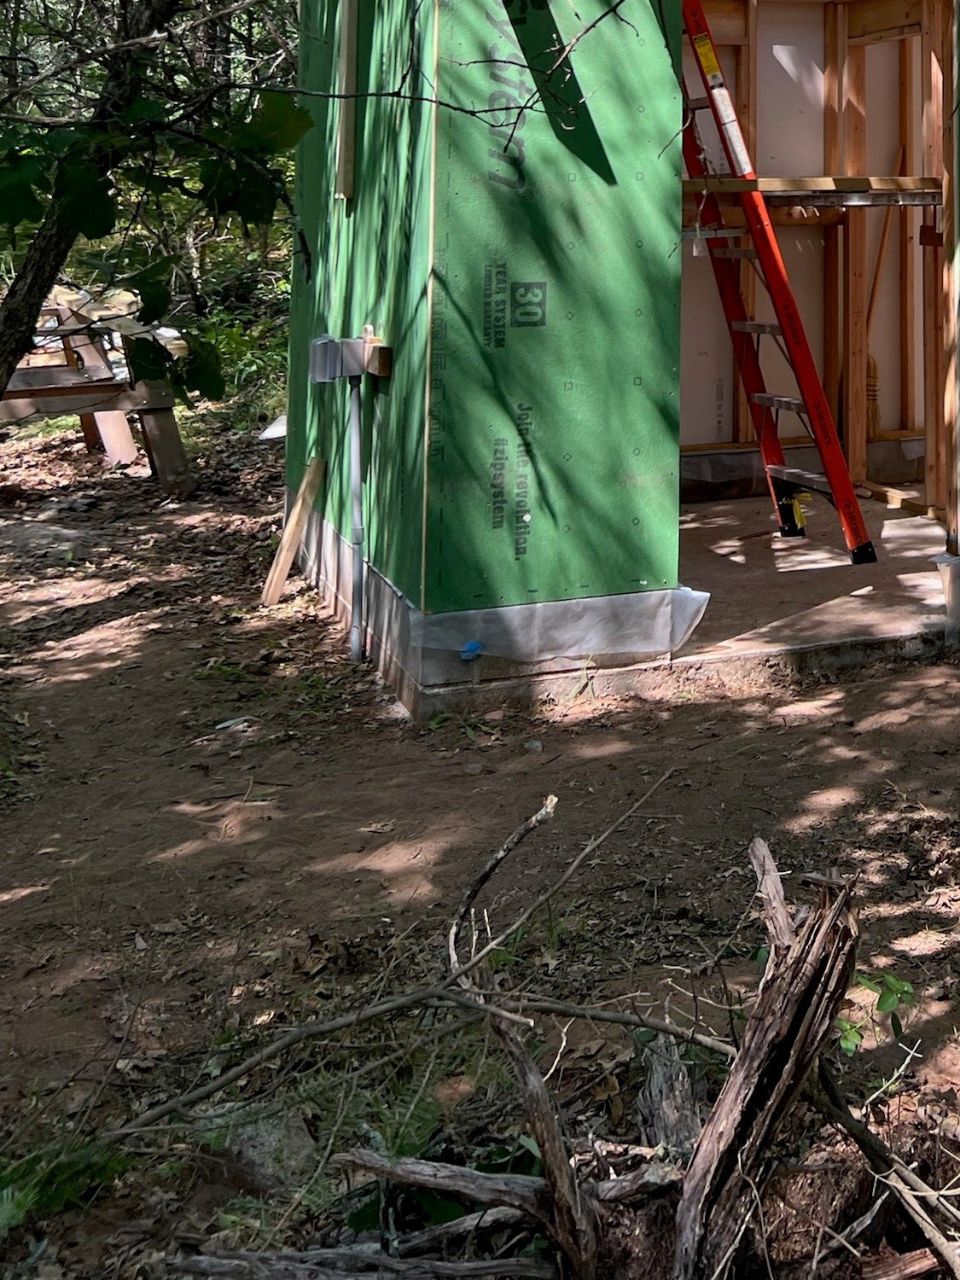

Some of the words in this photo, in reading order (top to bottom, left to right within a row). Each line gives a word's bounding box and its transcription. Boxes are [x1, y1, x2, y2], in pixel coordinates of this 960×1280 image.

[495, 262, 508, 295] YEAR
[494, 299, 507, 350] SYSTEM
[514, 286, 544, 323] 30
[490, 438, 509, 530] #zipsystem
